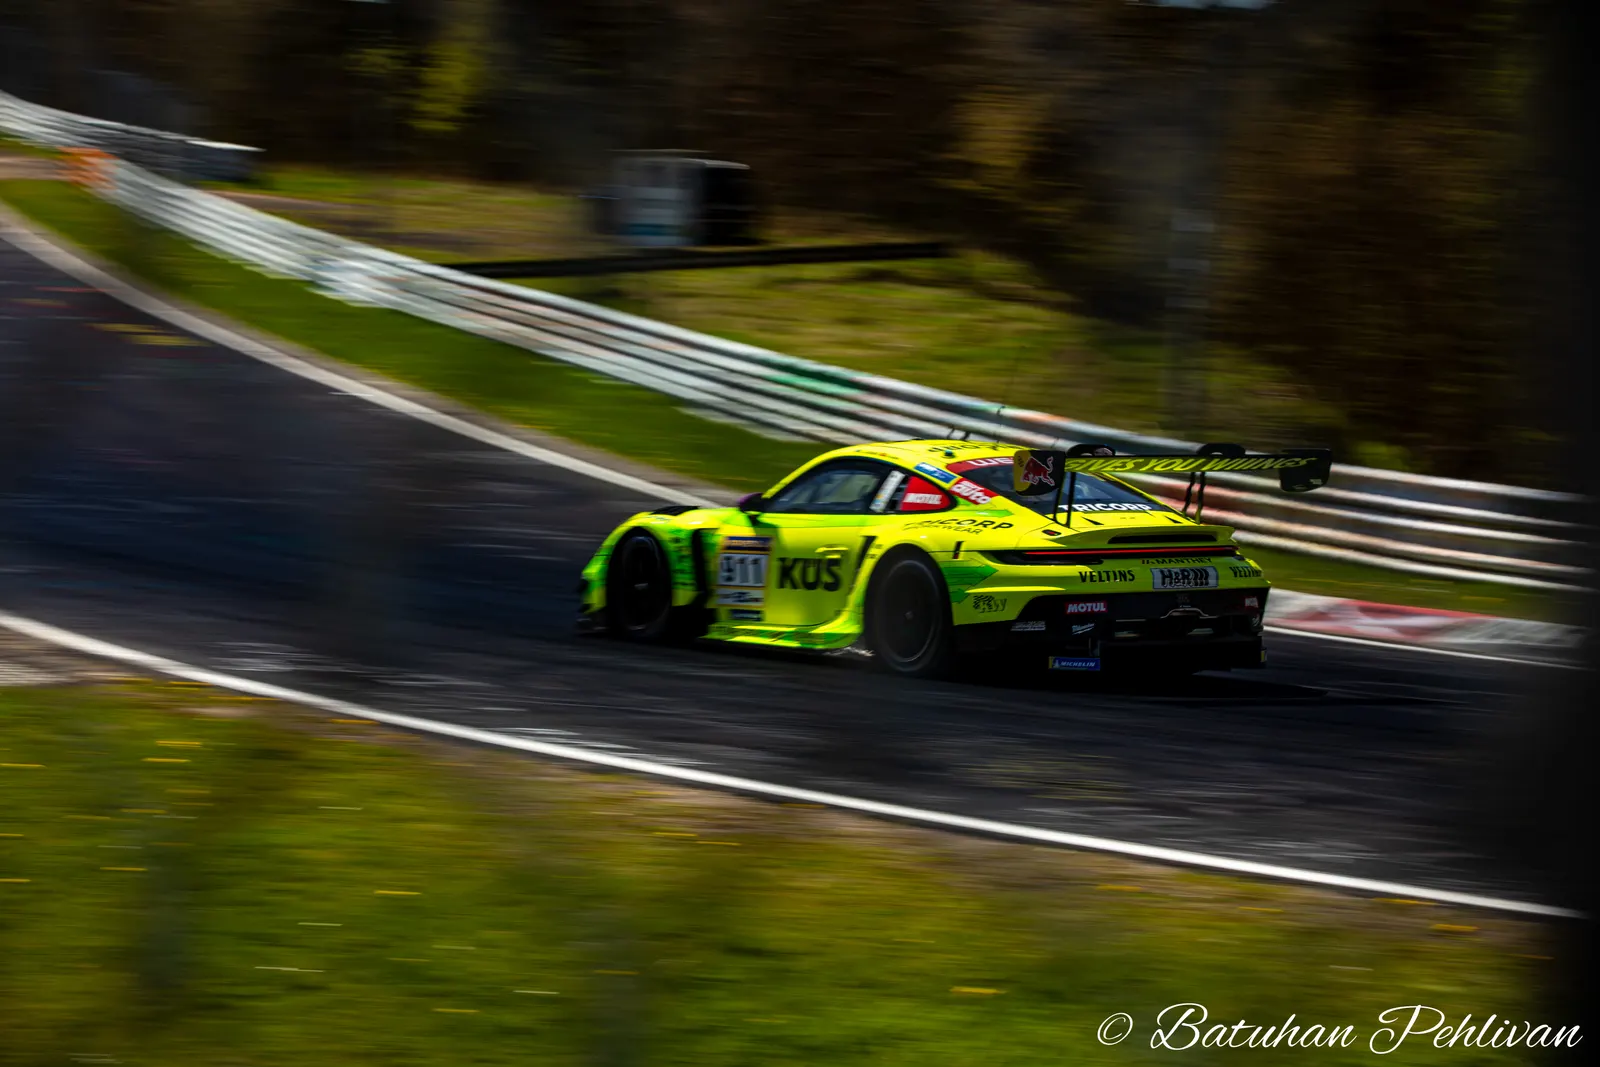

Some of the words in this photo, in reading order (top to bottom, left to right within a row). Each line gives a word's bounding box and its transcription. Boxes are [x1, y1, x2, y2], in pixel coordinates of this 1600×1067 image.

[1065, 458, 1141, 472] GIVES
[1139, 458, 1206, 472] YOU
[951, 481, 992, 505] auto
[1058, 503, 1153, 512] TRICORP
[1156, 557, 1212, 565] MANTHEY
[720, 554, 764, 585] 911
[776, 557, 842, 592] KUS
[1079, 570, 1135, 583] VELTINS
[1067, 602, 1107, 613] MOTUL
[1060, 660, 1096, 668] MICHELIN
